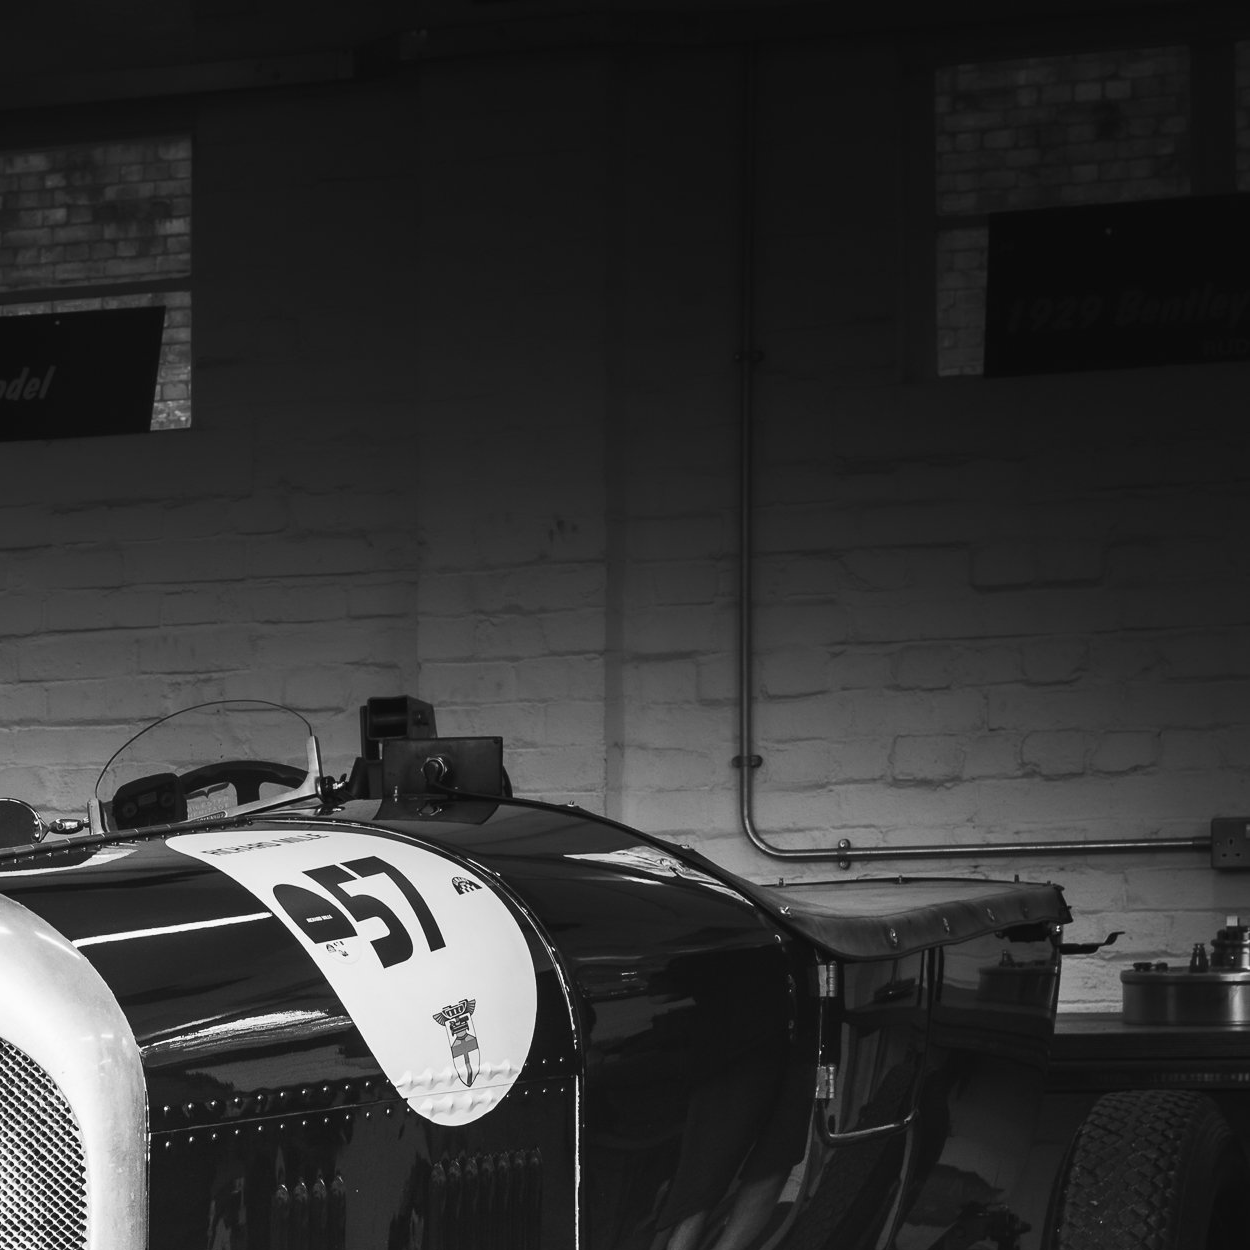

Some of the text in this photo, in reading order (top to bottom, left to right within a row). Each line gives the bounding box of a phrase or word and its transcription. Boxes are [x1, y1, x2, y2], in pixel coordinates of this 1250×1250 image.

[1007, 281, 1250, 335] 1929 Bentley
[303, 855, 447, 969] 57
